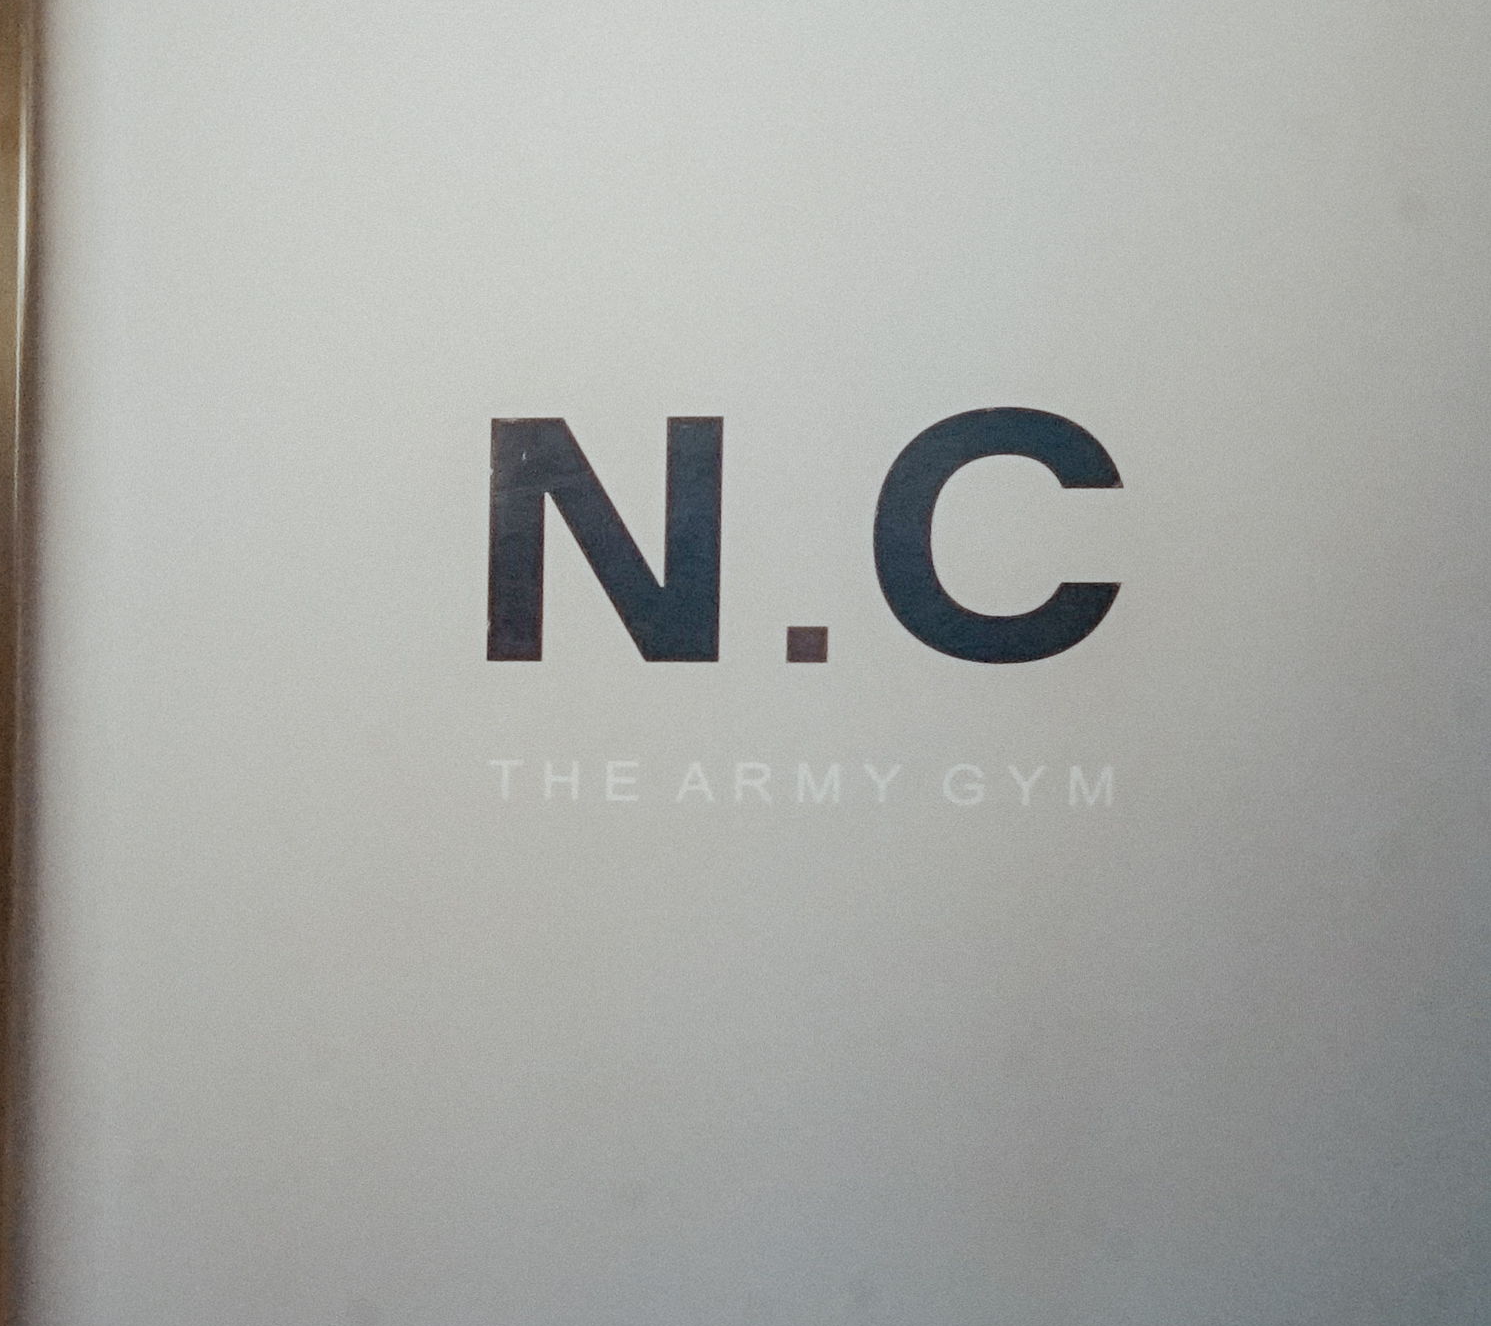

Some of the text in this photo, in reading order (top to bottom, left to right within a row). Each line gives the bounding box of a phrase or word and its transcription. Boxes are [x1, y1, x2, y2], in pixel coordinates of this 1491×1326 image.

[486, 406, 1124, 665] N.C
[489, 758, 1115, 807] THE ARMY GYM
